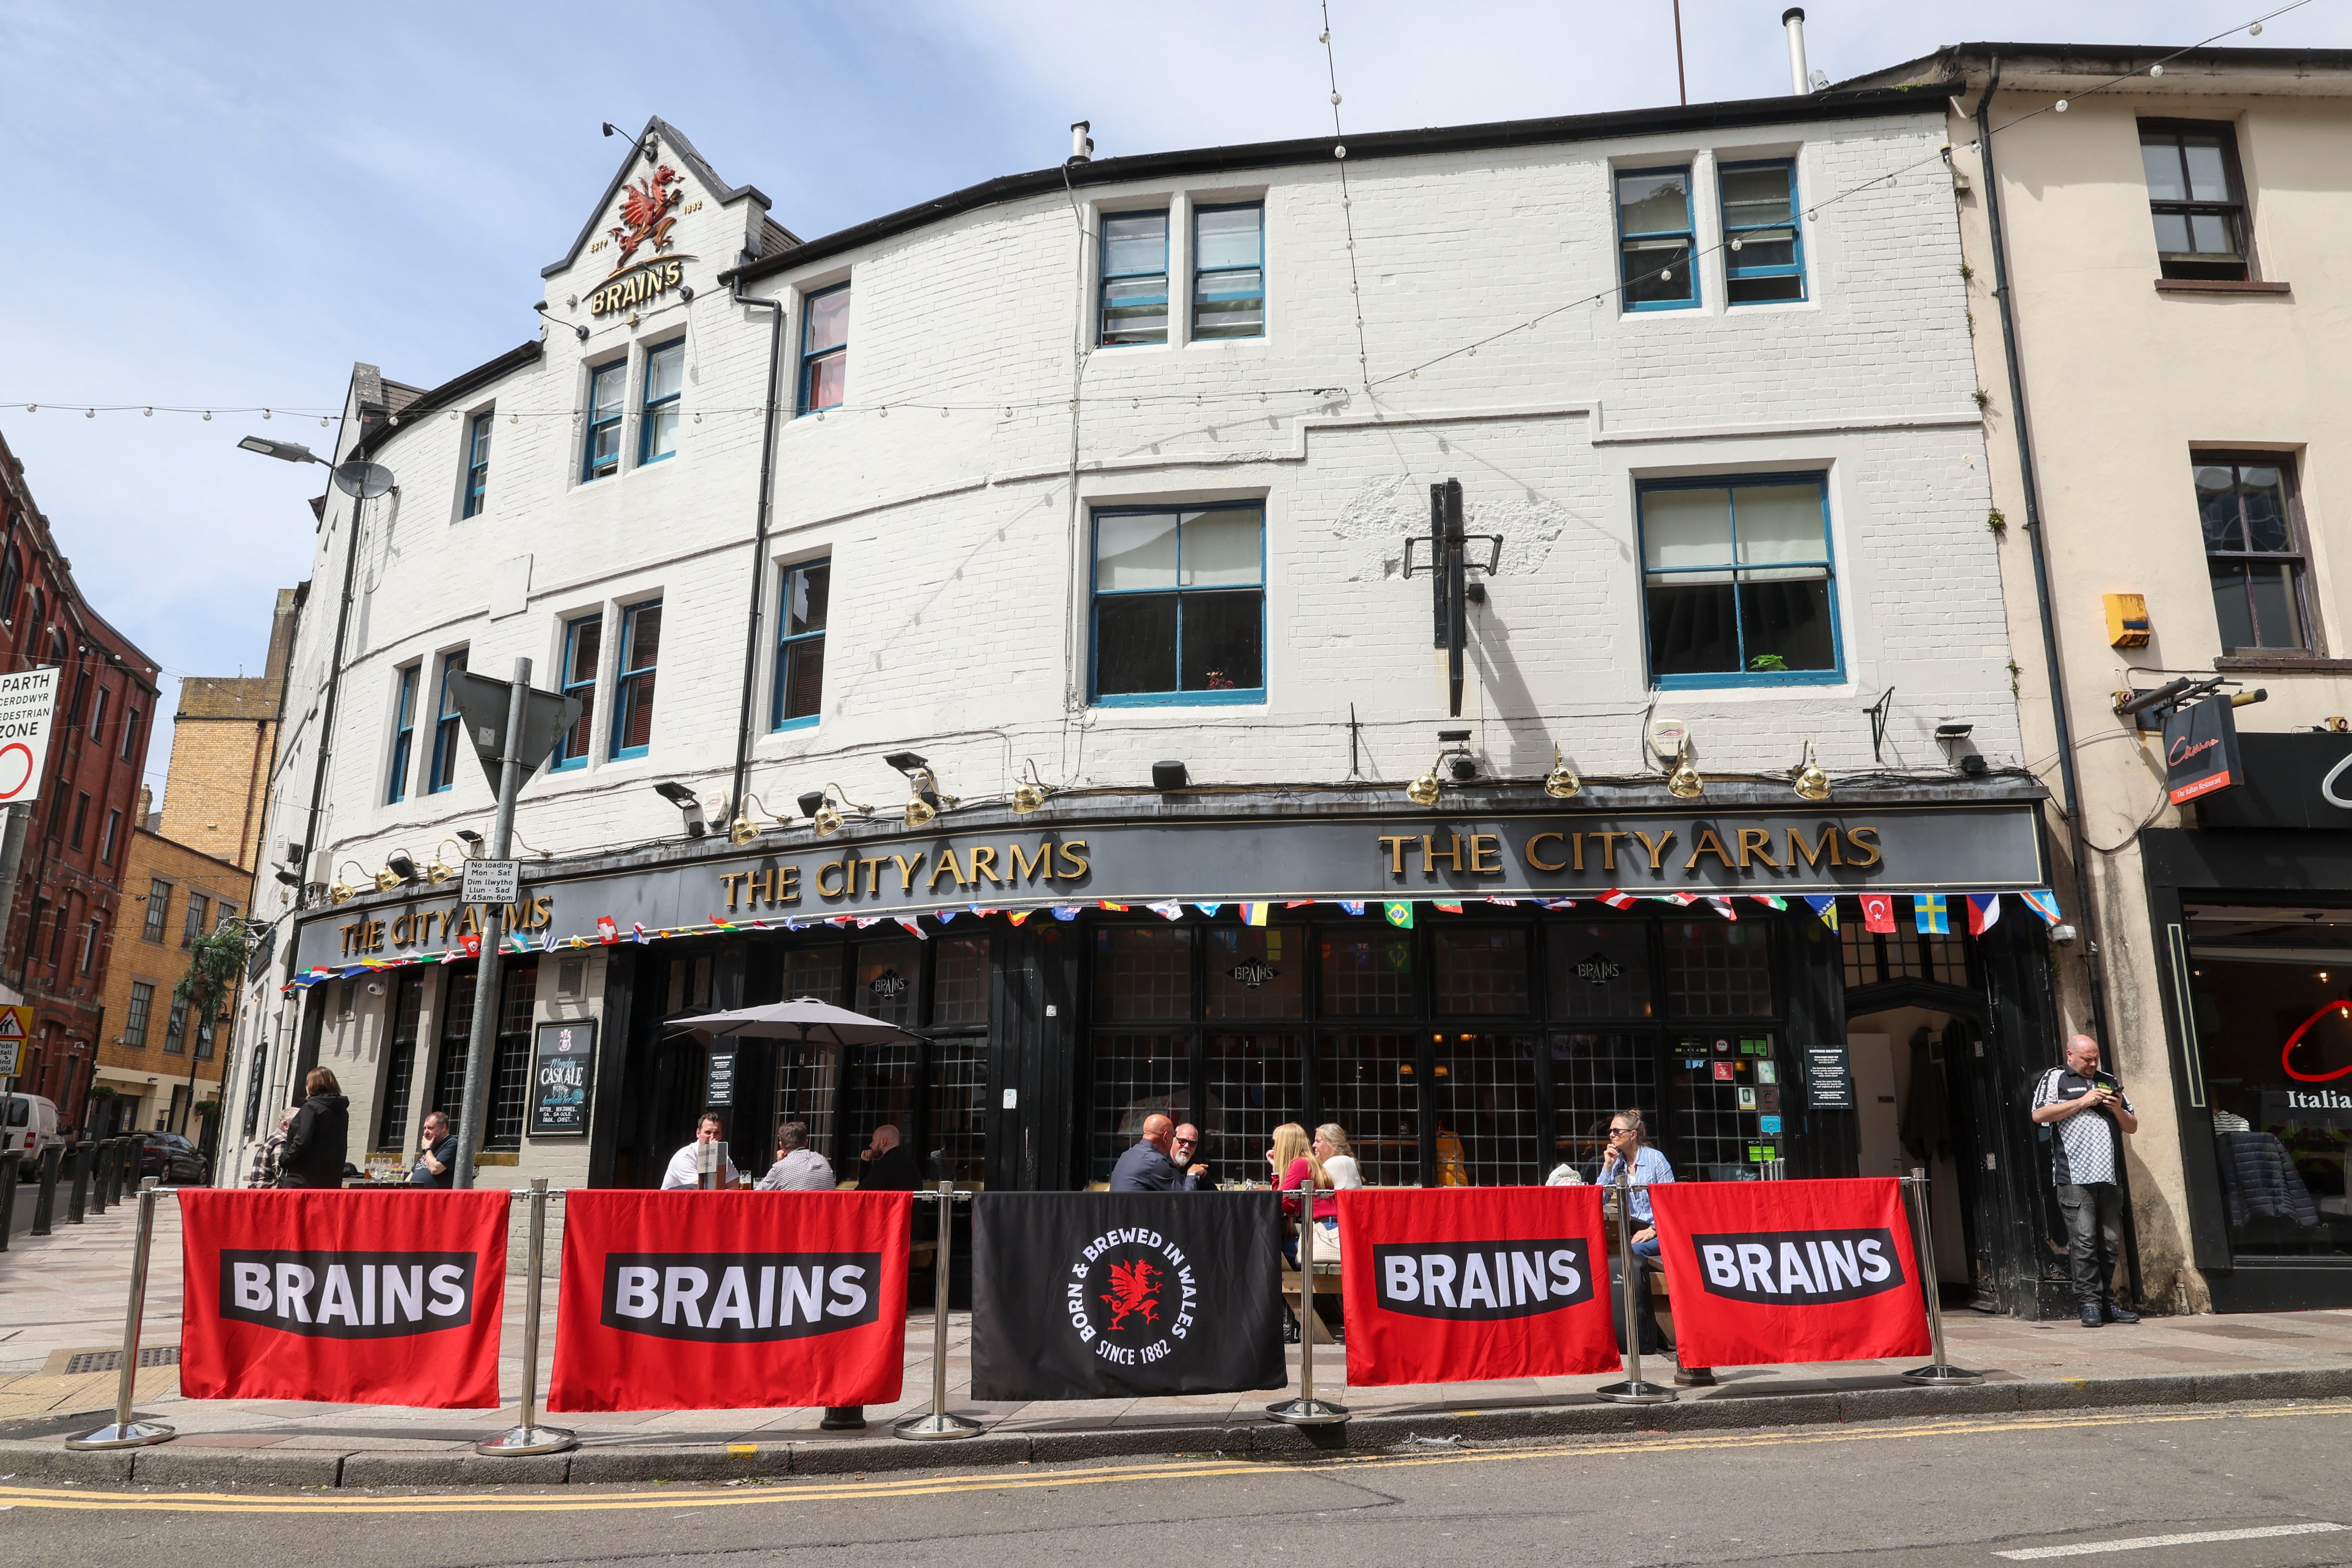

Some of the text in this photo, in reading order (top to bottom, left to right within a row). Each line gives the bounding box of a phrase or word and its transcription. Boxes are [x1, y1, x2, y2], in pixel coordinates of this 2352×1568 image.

[683, 200, 702, 215] 1882
[591, 260, 682, 314] BRAINS
[2, 674, 50, 692] PARTH
[0, 722, 39, 738] ZONE
[2185, 786, 2198, 795] Italian
[2199, 777, 2222, 790] Restaurant
[1378, 826, 1880, 873] THE CITY ARMS
[719, 840, 1088, 907] THE CITY ARMS
[339, 896, 553, 953] THE CITY AMS
[541, 1067, 583, 1086] CASK ALE
[549, 1057, 576, 1068] Monday
[542, 1095, 564, 1106] Available
[1067, 1227, 1197, 1343] BORN & BREWED IN WALES
[1384, 1250, 1581, 1309] BRAINS
[1703, 1238, 1891, 1294] BRAINS
[234, 1262, 465, 1326] BRAINS
[615, 1265, 867, 1329] BRAINS
[1096, 1339, 1171, 1365] SINCE 1882
